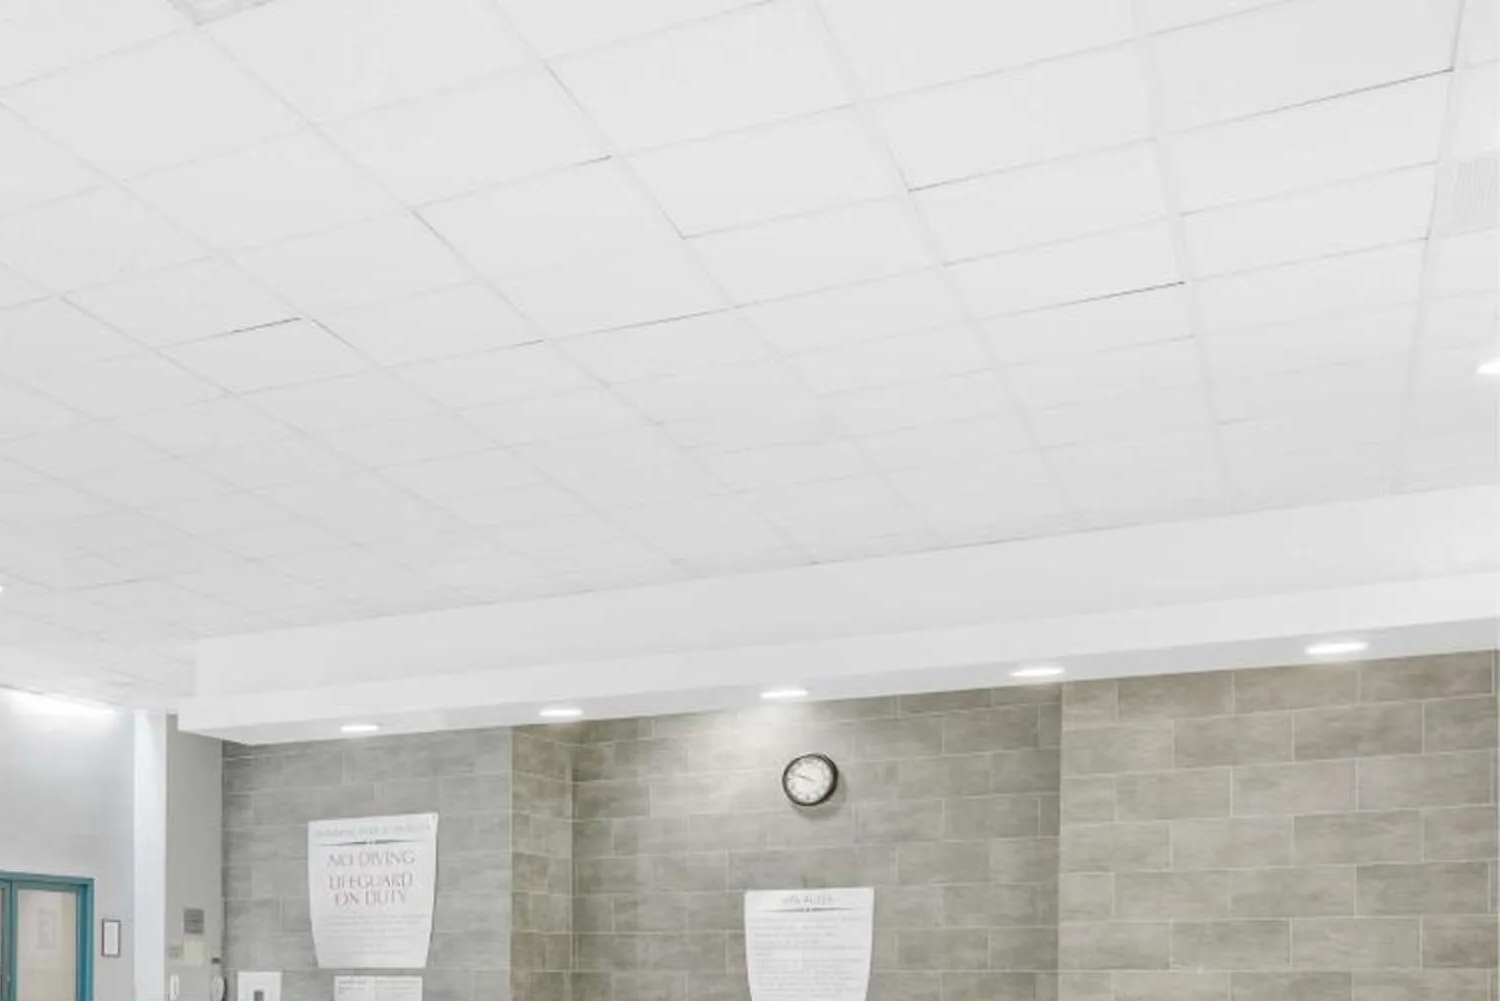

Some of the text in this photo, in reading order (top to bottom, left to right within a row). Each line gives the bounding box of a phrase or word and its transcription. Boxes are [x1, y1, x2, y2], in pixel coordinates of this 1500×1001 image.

[357, 850, 415, 867] DIVING
[329, 873, 413, 890] LIFEGUARD
[334, 889, 406, 907] ON DUTY
